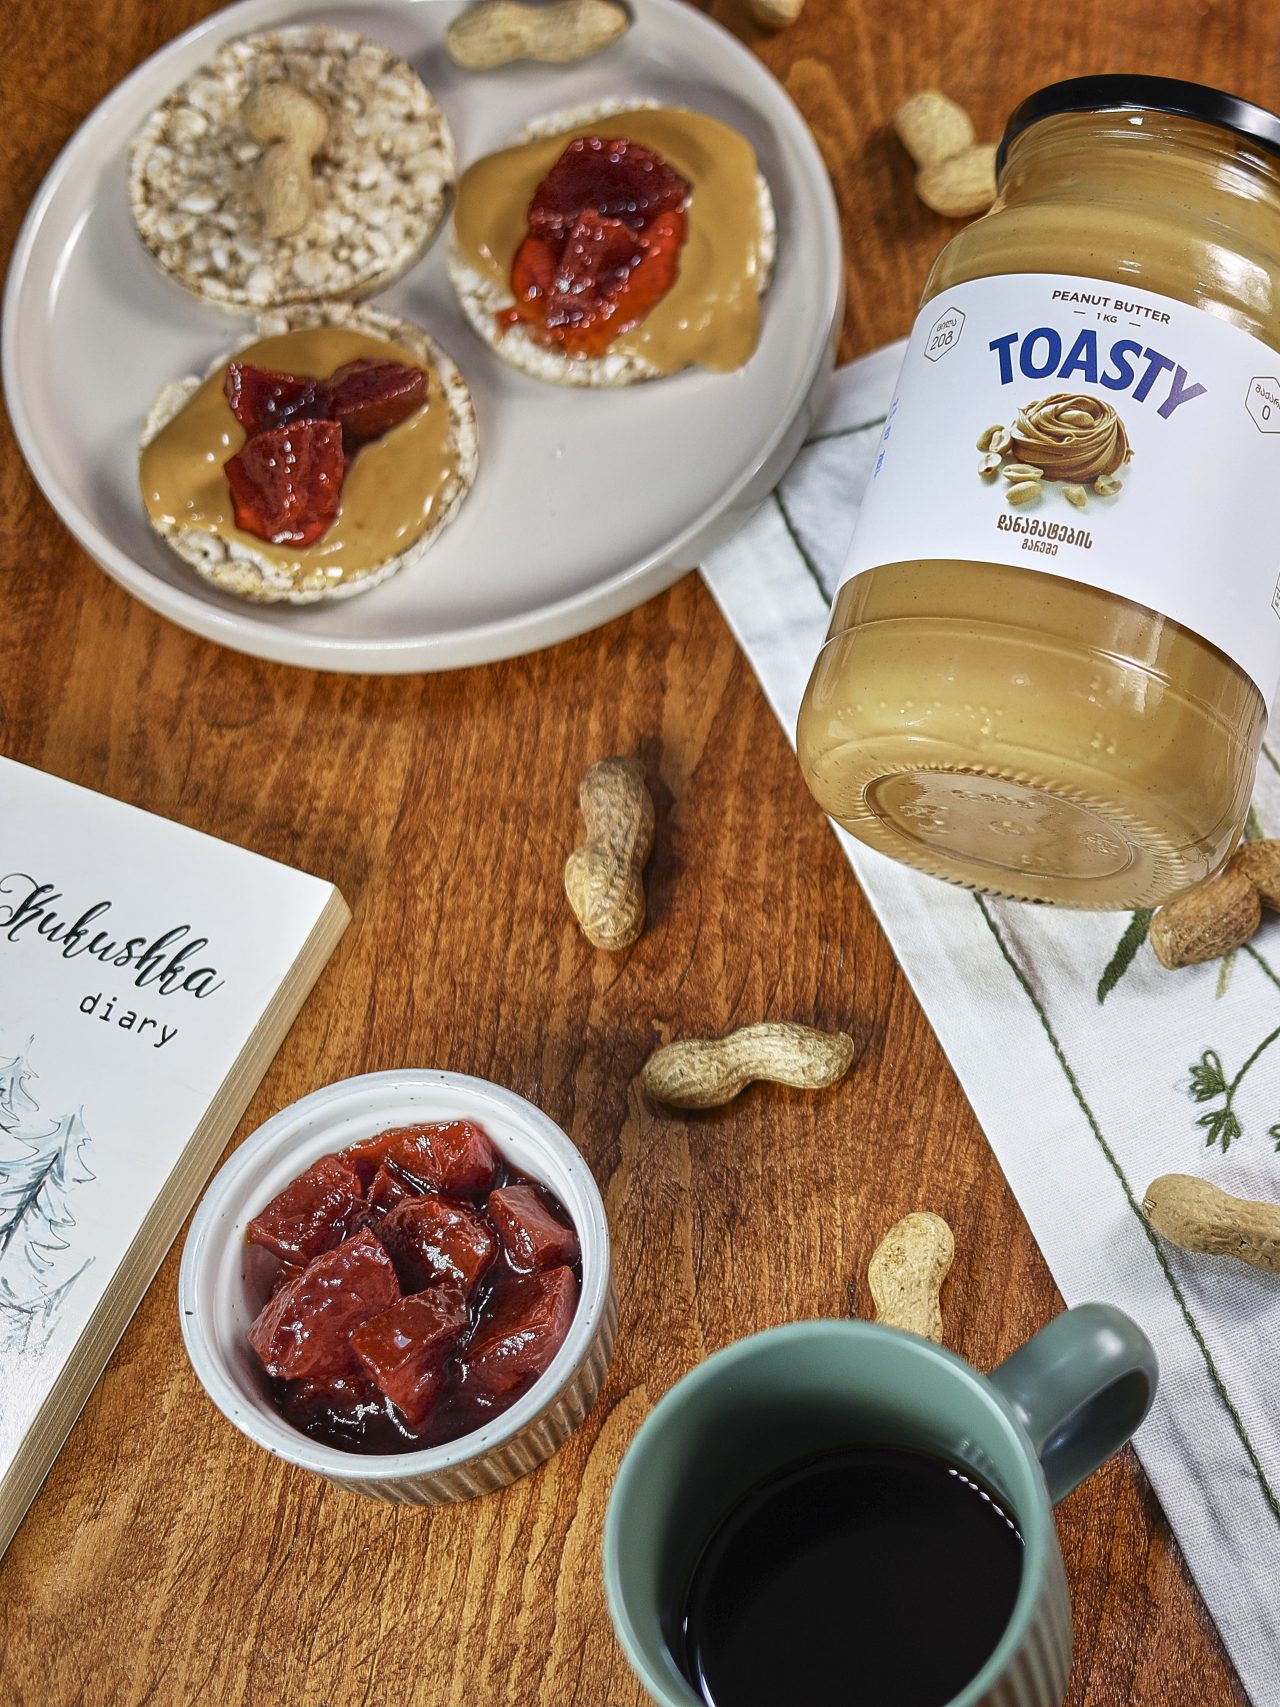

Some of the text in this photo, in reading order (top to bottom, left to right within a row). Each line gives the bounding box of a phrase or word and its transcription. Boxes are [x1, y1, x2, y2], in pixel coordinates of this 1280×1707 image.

[1052, 290, 1171, 324] PEANUT BUTTER
[1096, 312, 1118, 323] 1 KG
[989, 327, 1208, 420] TOASTY
[1262, 405, 1270, 420] 0
[997, 514, 1093, 549] დანამატების
[1021, 538, 1058, 556] გარეშე
[0, 873, 225, 998] Kukushka
[79, 992, 178, 1048] diary
